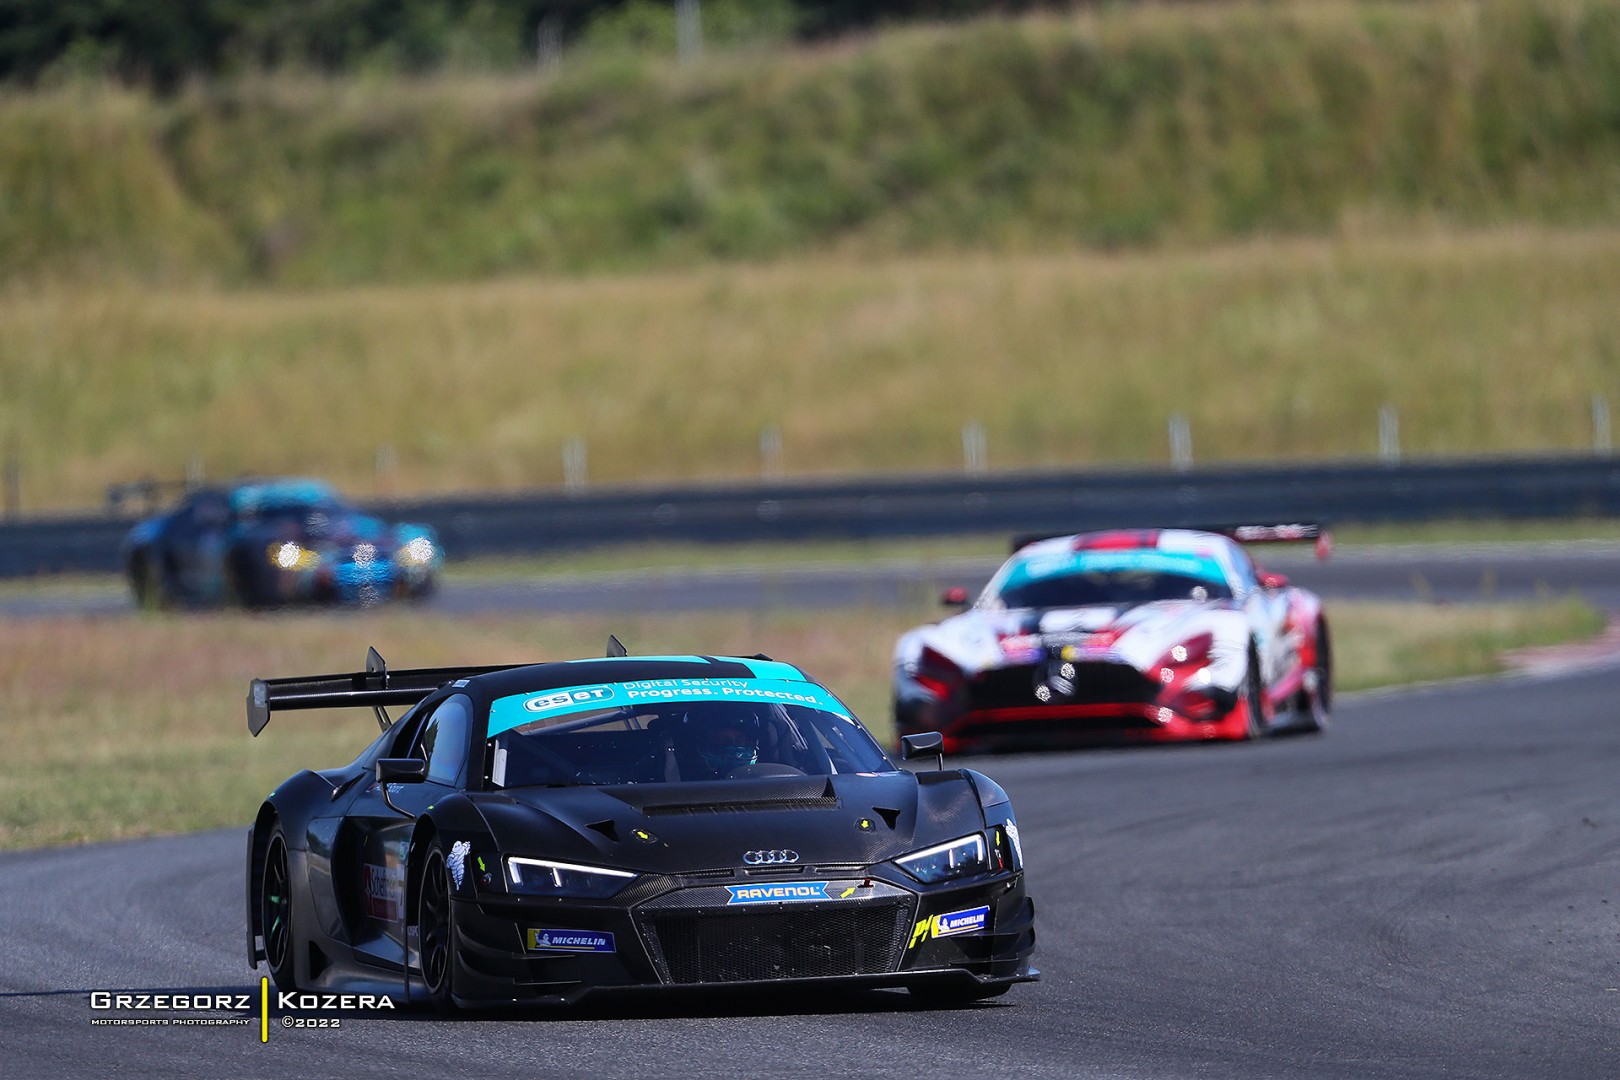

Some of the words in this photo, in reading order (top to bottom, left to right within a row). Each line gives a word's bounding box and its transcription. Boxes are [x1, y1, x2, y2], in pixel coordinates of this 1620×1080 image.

[623, 679, 677, 690] Digital
[681, 678, 748, 690] Security
[628, 687, 718, 699] Progress.
[723, 687, 823, 705] Protected.
[949, 913, 985, 928] MICHELIN
[552, 936, 606, 946] MICHELIN
